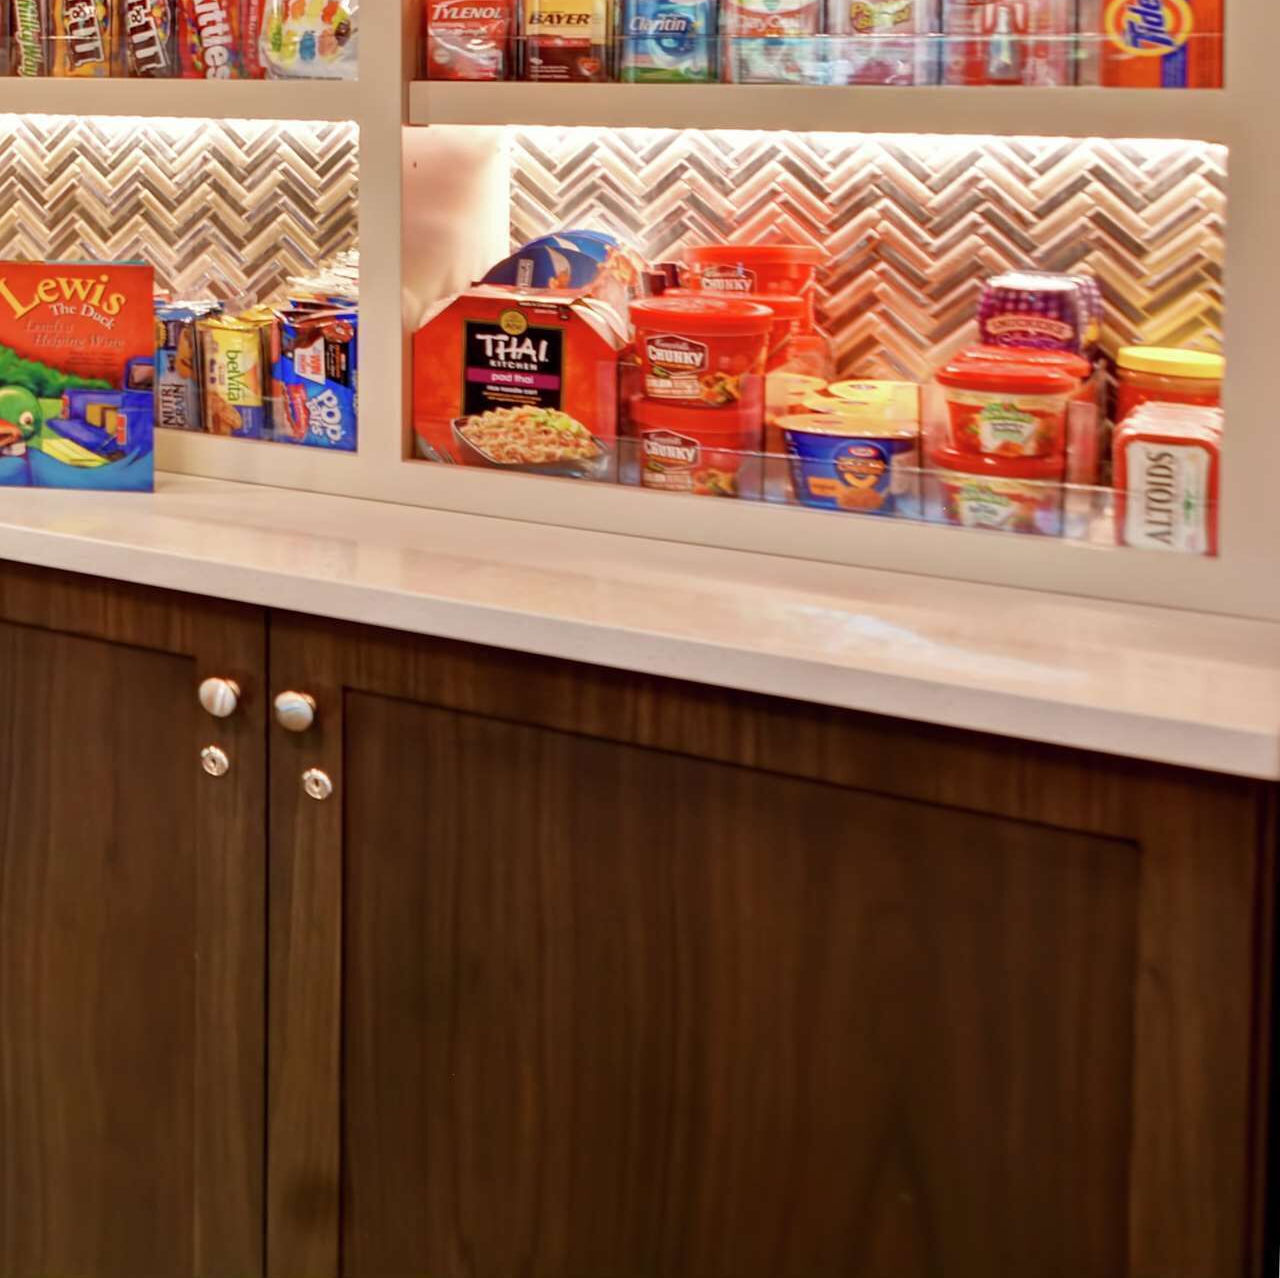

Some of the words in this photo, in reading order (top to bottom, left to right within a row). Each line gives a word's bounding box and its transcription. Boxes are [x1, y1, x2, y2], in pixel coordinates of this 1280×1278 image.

[431, 4, 502, 21] TYLENOL
[528, 13, 591, 26] BAYER
[629, 14, 687, 32] Claritin
[48, 304, 77, 317] The
[80, 304, 116, 330] Duck
[476, 333, 549, 362] THAI
[647, 344, 705, 368] CHUNKY
[225, 349, 250, 403] belVita
[489, 360, 538, 371] KITCHEN
[173, 382, 188, 429] GRAIN
[644, 439, 696, 462] CHUNKY
[1144, 450, 1175, 545] ALTOIDS
